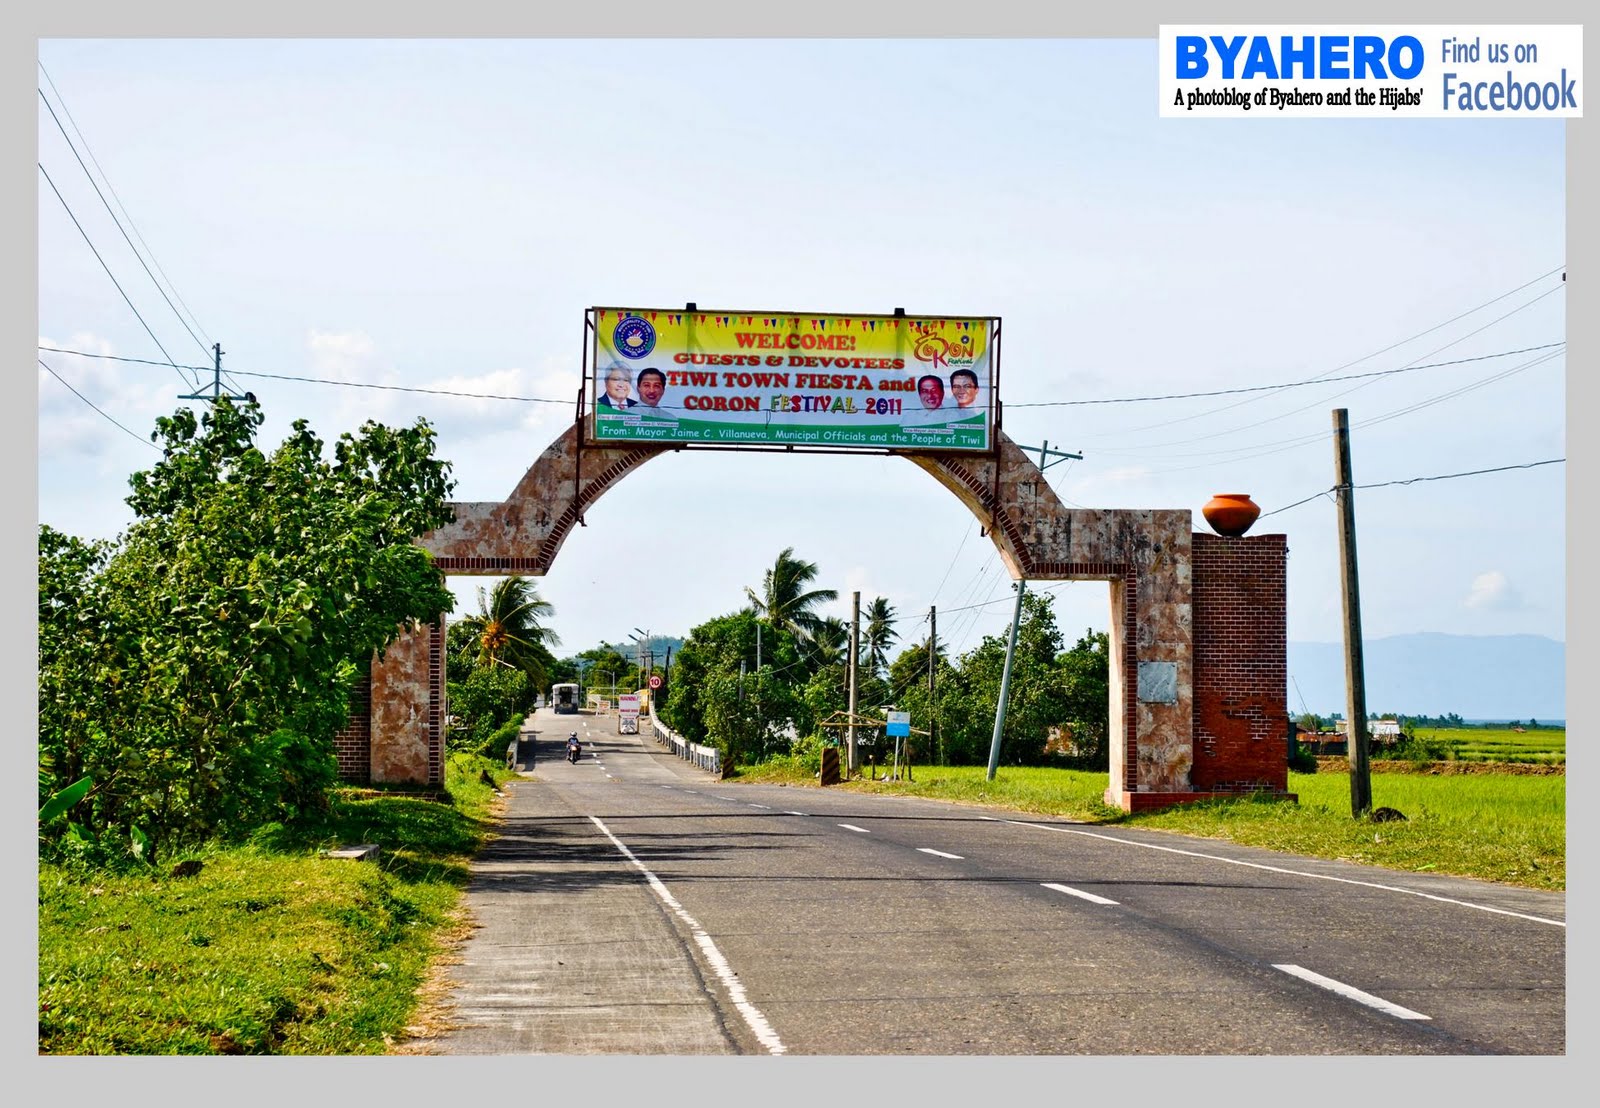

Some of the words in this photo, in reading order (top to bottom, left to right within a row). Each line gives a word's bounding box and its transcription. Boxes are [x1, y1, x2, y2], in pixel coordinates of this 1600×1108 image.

[736, 333, 855, 350] WELCOME!
[674, 353, 760, 366] GUESTS
[765, 354, 782, 366] &
[789, 356, 904, 369] DEVOTEES
[667, 371, 717, 386] TIWI
[723, 373, 789, 387] TOWN
[796, 374, 873, 390] FIESTA
[879, 376, 916, 391] and
[684, 395, 760, 411] CORON
[771, 394, 858, 413] FESTIVAL
[866, 398, 901, 414] 2011
[603, 426, 630, 435] From:
[636, 429, 666, 439] Mayor
[671, 430, 699, 438] Jaime
[704, 430, 713, 438] C.
[719, 430, 769, 439] Villanueva,
[776, 431, 819, 441] Municipal
[824, 432, 865, 441] Officials
[870, 433, 887, 441] and
[892, 433, 907, 442] the
[912, 434, 941, 444] People
[946, 434, 956, 443] of
[960, 436, 980, 445] Tiwi
